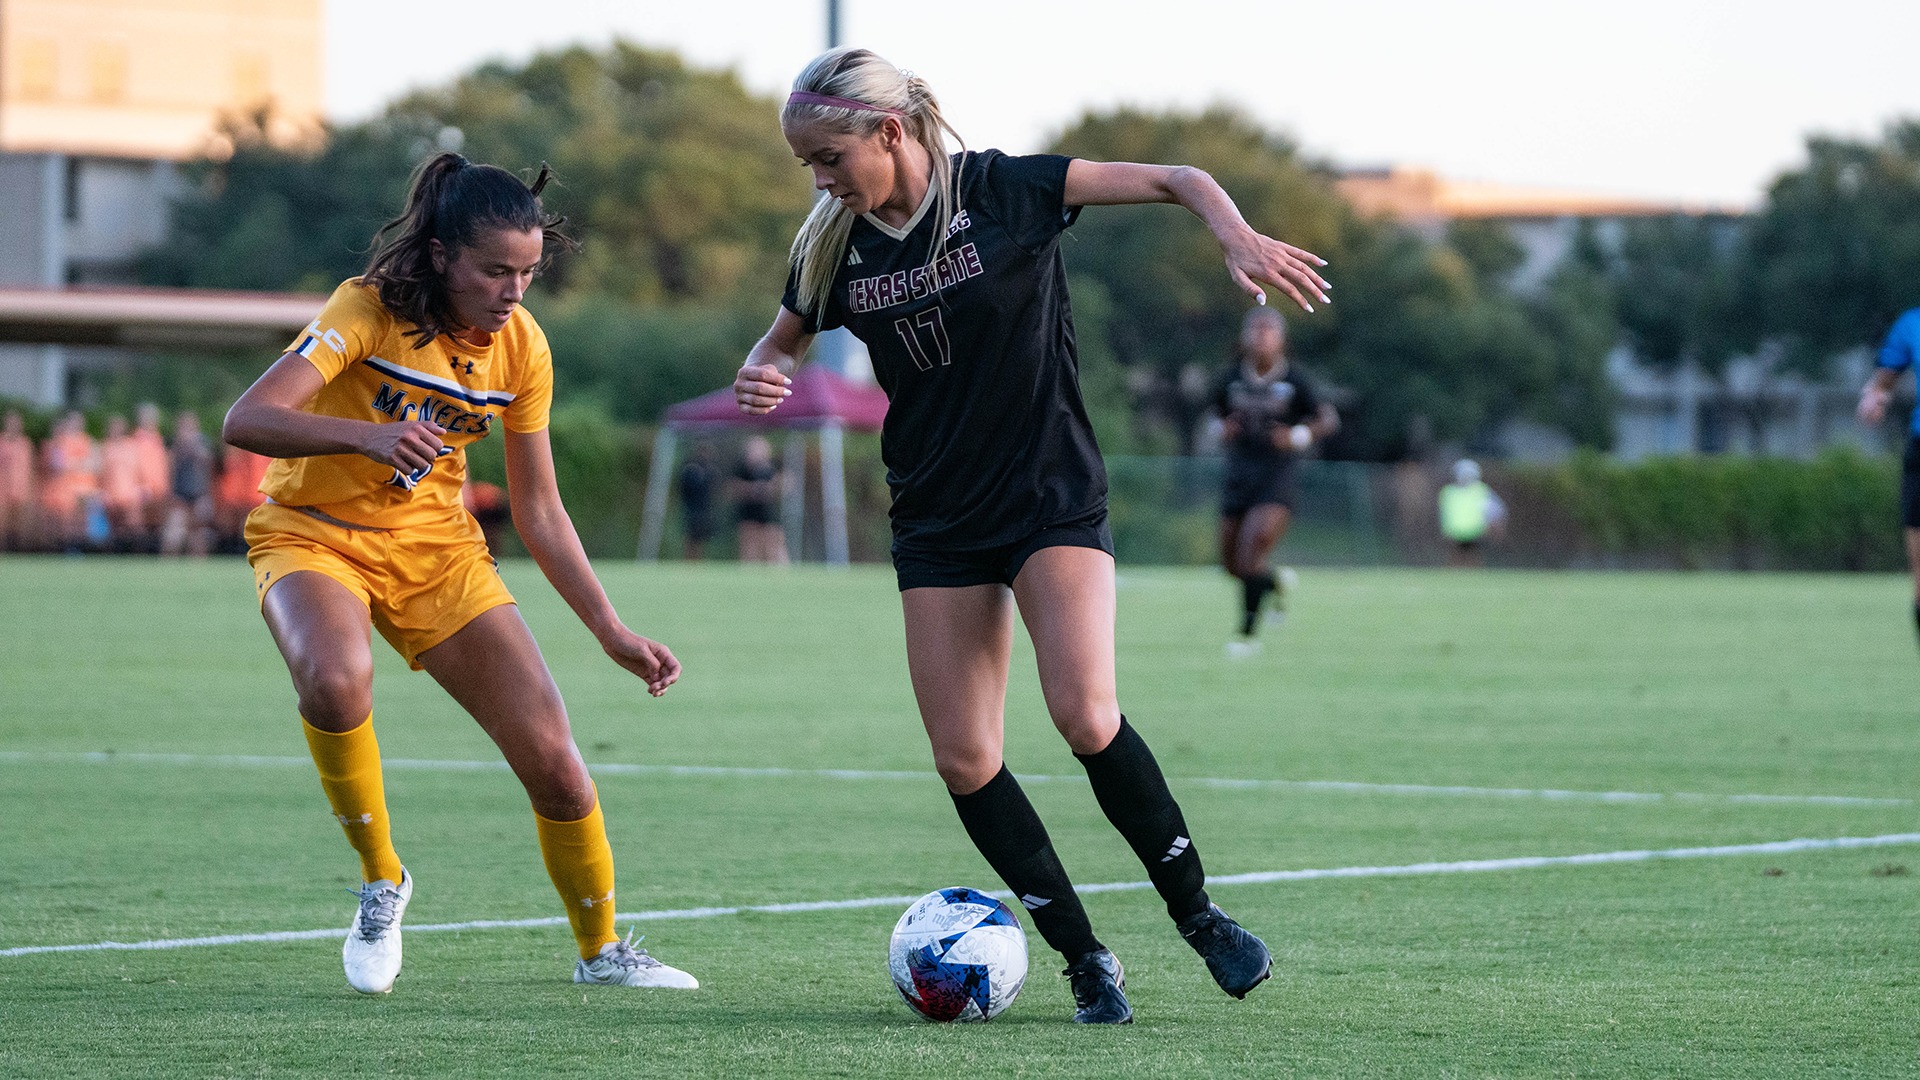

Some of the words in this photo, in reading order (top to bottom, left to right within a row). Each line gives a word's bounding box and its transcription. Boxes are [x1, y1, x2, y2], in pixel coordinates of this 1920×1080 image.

[849, 270, 909, 313] TEXAS
[910, 242, 984, 300] STATE
[894, 306, 951, 371] 17
